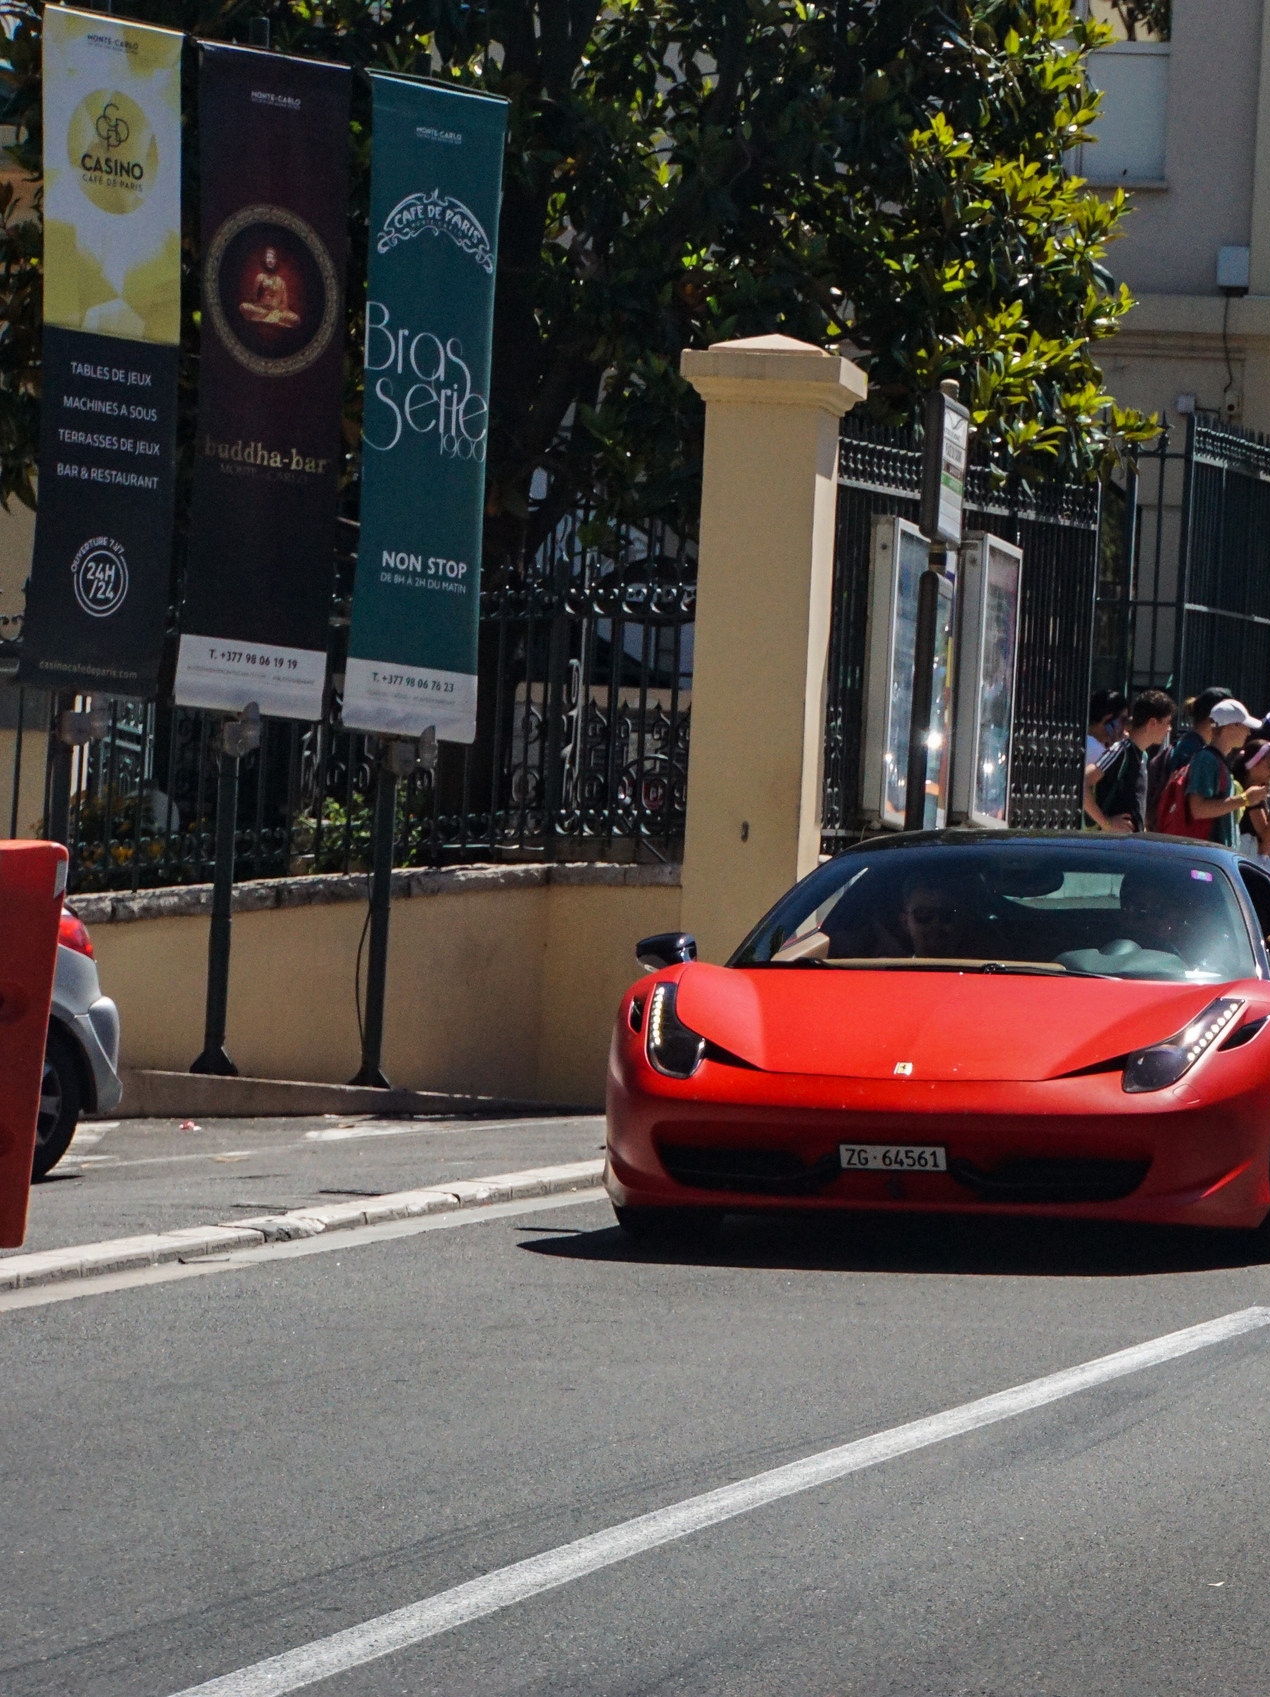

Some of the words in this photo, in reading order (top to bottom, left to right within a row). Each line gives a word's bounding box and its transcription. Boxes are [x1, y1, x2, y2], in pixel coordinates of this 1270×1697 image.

[81, 153, 143, 180] CASINO
[106, 176, 117, 186] DE
[119, 179, 143, 192] PARIS
[427, 205, 443, 220] DE
[445, 209, 482, 244] PARIS
[70, 361, 110, 380] TABLES
[111, 368, 125, 382] DE
[127, 371, 152, 386] JEUX
[63, 394, 119, 416] MACHINES
[129, 405, 158, 421] SOUS
[58, 428, 119, 450] TERRASSES
[120, 438, 134, 452] DE
[135, 441, 161, 456] JEUX
[204, 433, 328, 474] buddha-bar
[57, 462, 79, 478] BAR
[80, 466, 89, 480] &
[90, 467, 159, 490] RESTAURANT
[70, 536, 109, 573] OUVERTURE
[382, 550, 422, 572] NON
[427, 556, 467, 579] STOP
[86, 561, 116, 582] 24H
[380, 572, 392, 582] DE
[414, 576, 426, 588] 2H
[427, 579, 440, 590] DU
[442, 581, 467, 595] MATIN
[209, 649, 217, 660] T.
[221, 651, 243, 663] +377
[245, 653, 257, 665] 98
[259, 655, 270, 666] 06
[274, 657, 284, 668] 19
[287, 659, 298, 670] 19
[372, 672, 380, 682] T.
[382, 673, 404, 686] +377
[405, 676, 415, 688] 98
[417, 679, 428, 690] 06
[431, 680, 442, 691] 76
[444, 682, 454, 693] 23
[845, 1148, 869, 1166] ZG
[882, 1149, 940, 1168] 64561
